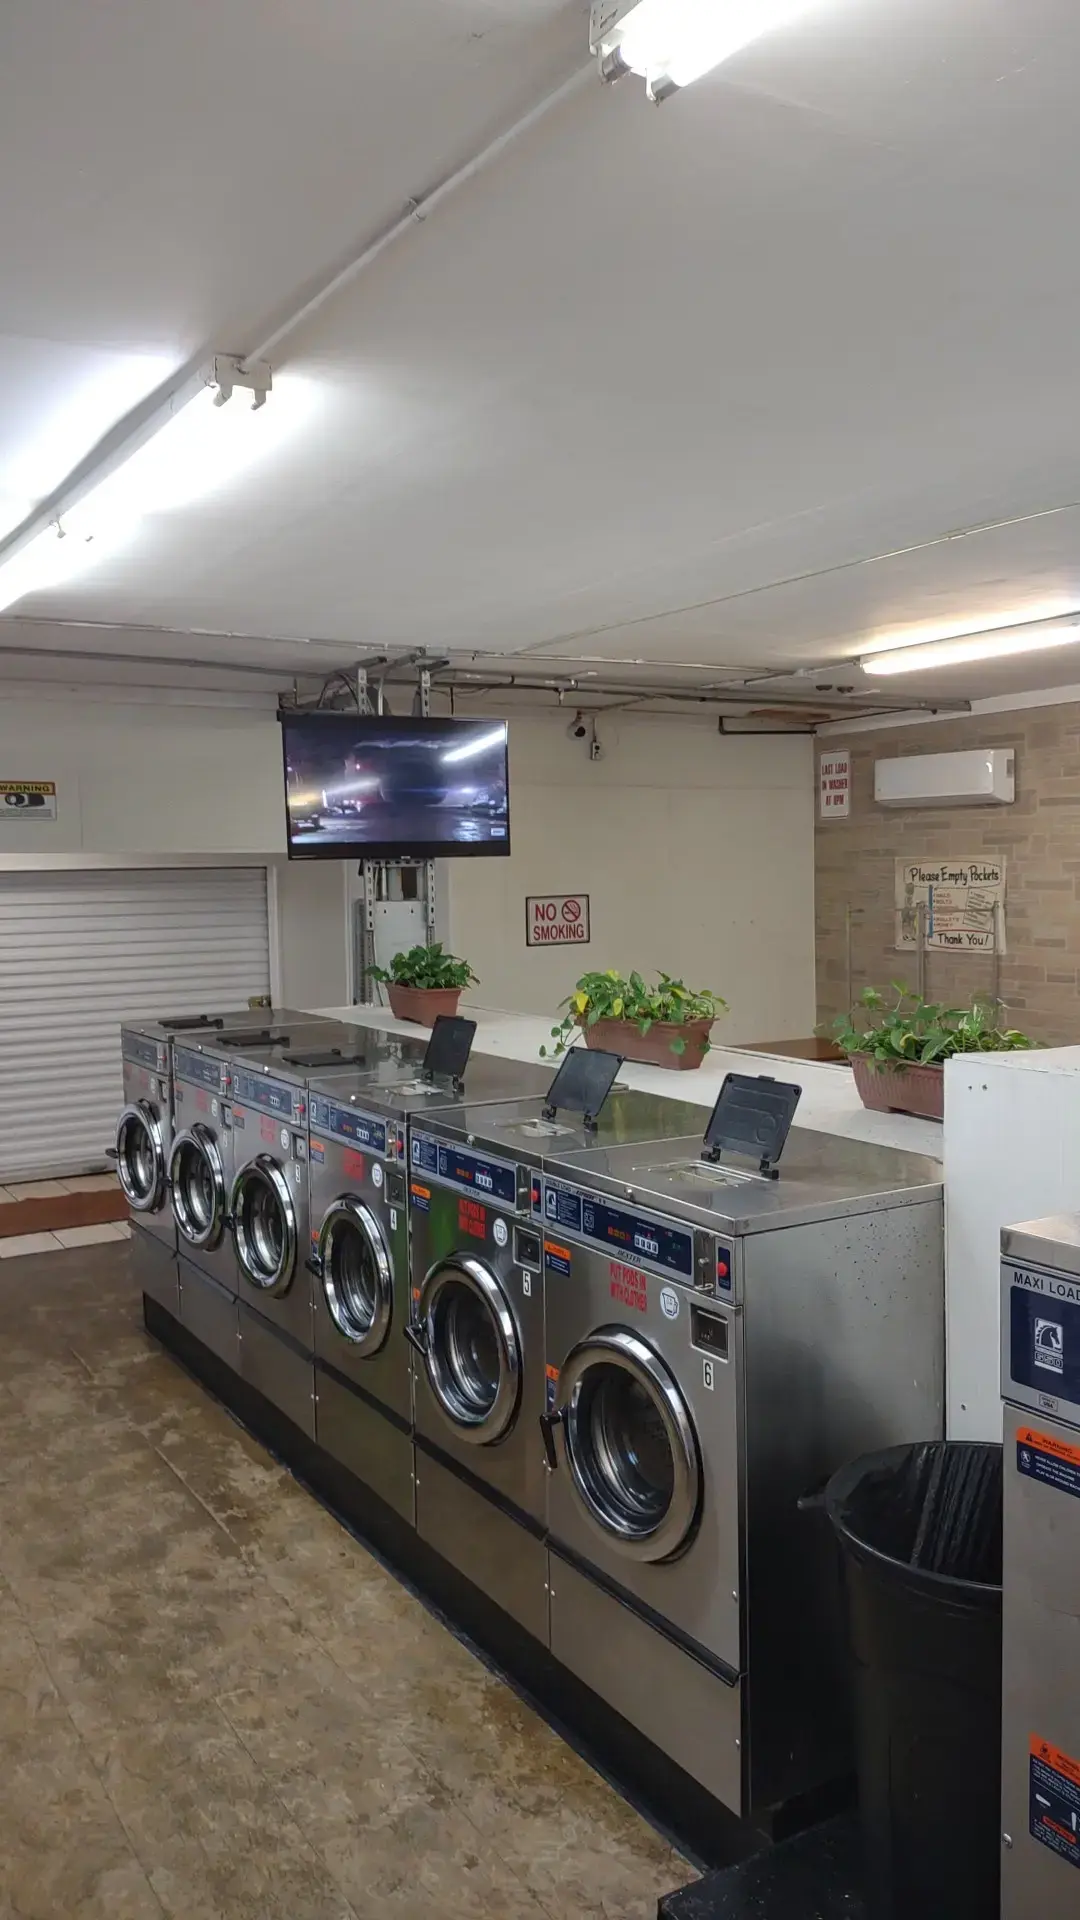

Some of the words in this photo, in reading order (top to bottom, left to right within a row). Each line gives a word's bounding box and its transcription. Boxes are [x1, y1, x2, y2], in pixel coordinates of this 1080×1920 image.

[822, 763, 833, 775] LAST
[835, 762, 847, 774] LOAD
[0, 784, 50, 792] WARNING
[909, 867, 940, 882] Please
[940, 866, 968, 886] Empty
[968, 864, 999, 881] Pockets
[534, 903, 557, 921] NO
[533, 923, 585, 941] SMOKING
[937, 933, 963, 945] Thank
[966, 932, 989, 946] You!
[617, 1249, 641, 1263] DEXTER
[523, 1272, 530, 1293] 5
[610, 1263, 622, 1280] PUT
[623, 1266, 640, 1289] PODS
[1014, 1271, 1044, 1290] MAXI
[704, 1362, 712, 1386] 6
